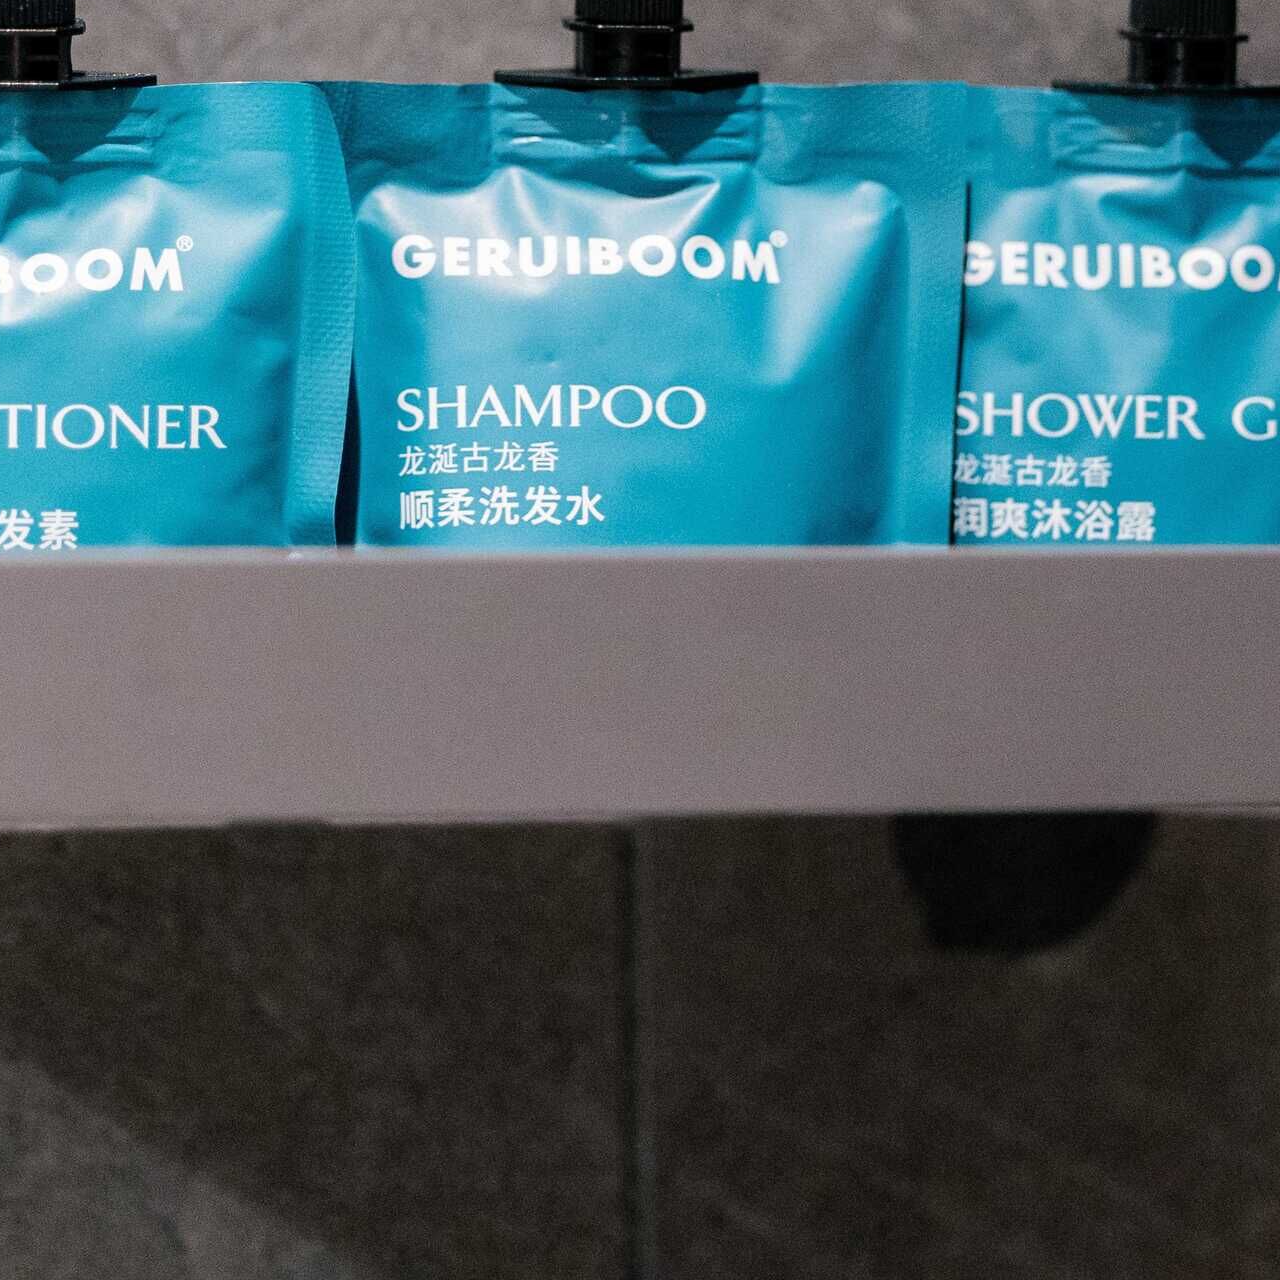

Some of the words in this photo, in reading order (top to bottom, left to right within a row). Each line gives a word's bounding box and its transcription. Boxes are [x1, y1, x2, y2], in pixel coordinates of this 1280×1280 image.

[391, 233, 782, 284] GERUIBOOM
[396, 383, 706, 432] SHAMPOO
[956, 392, 1205, 440] SHOWER
[398, 441, 560, 477] 龙涎古龙香
[399, 485, 605, 529] 顺柔洗发水
[953, 497, 1157, 542] 润爽沐浴露
